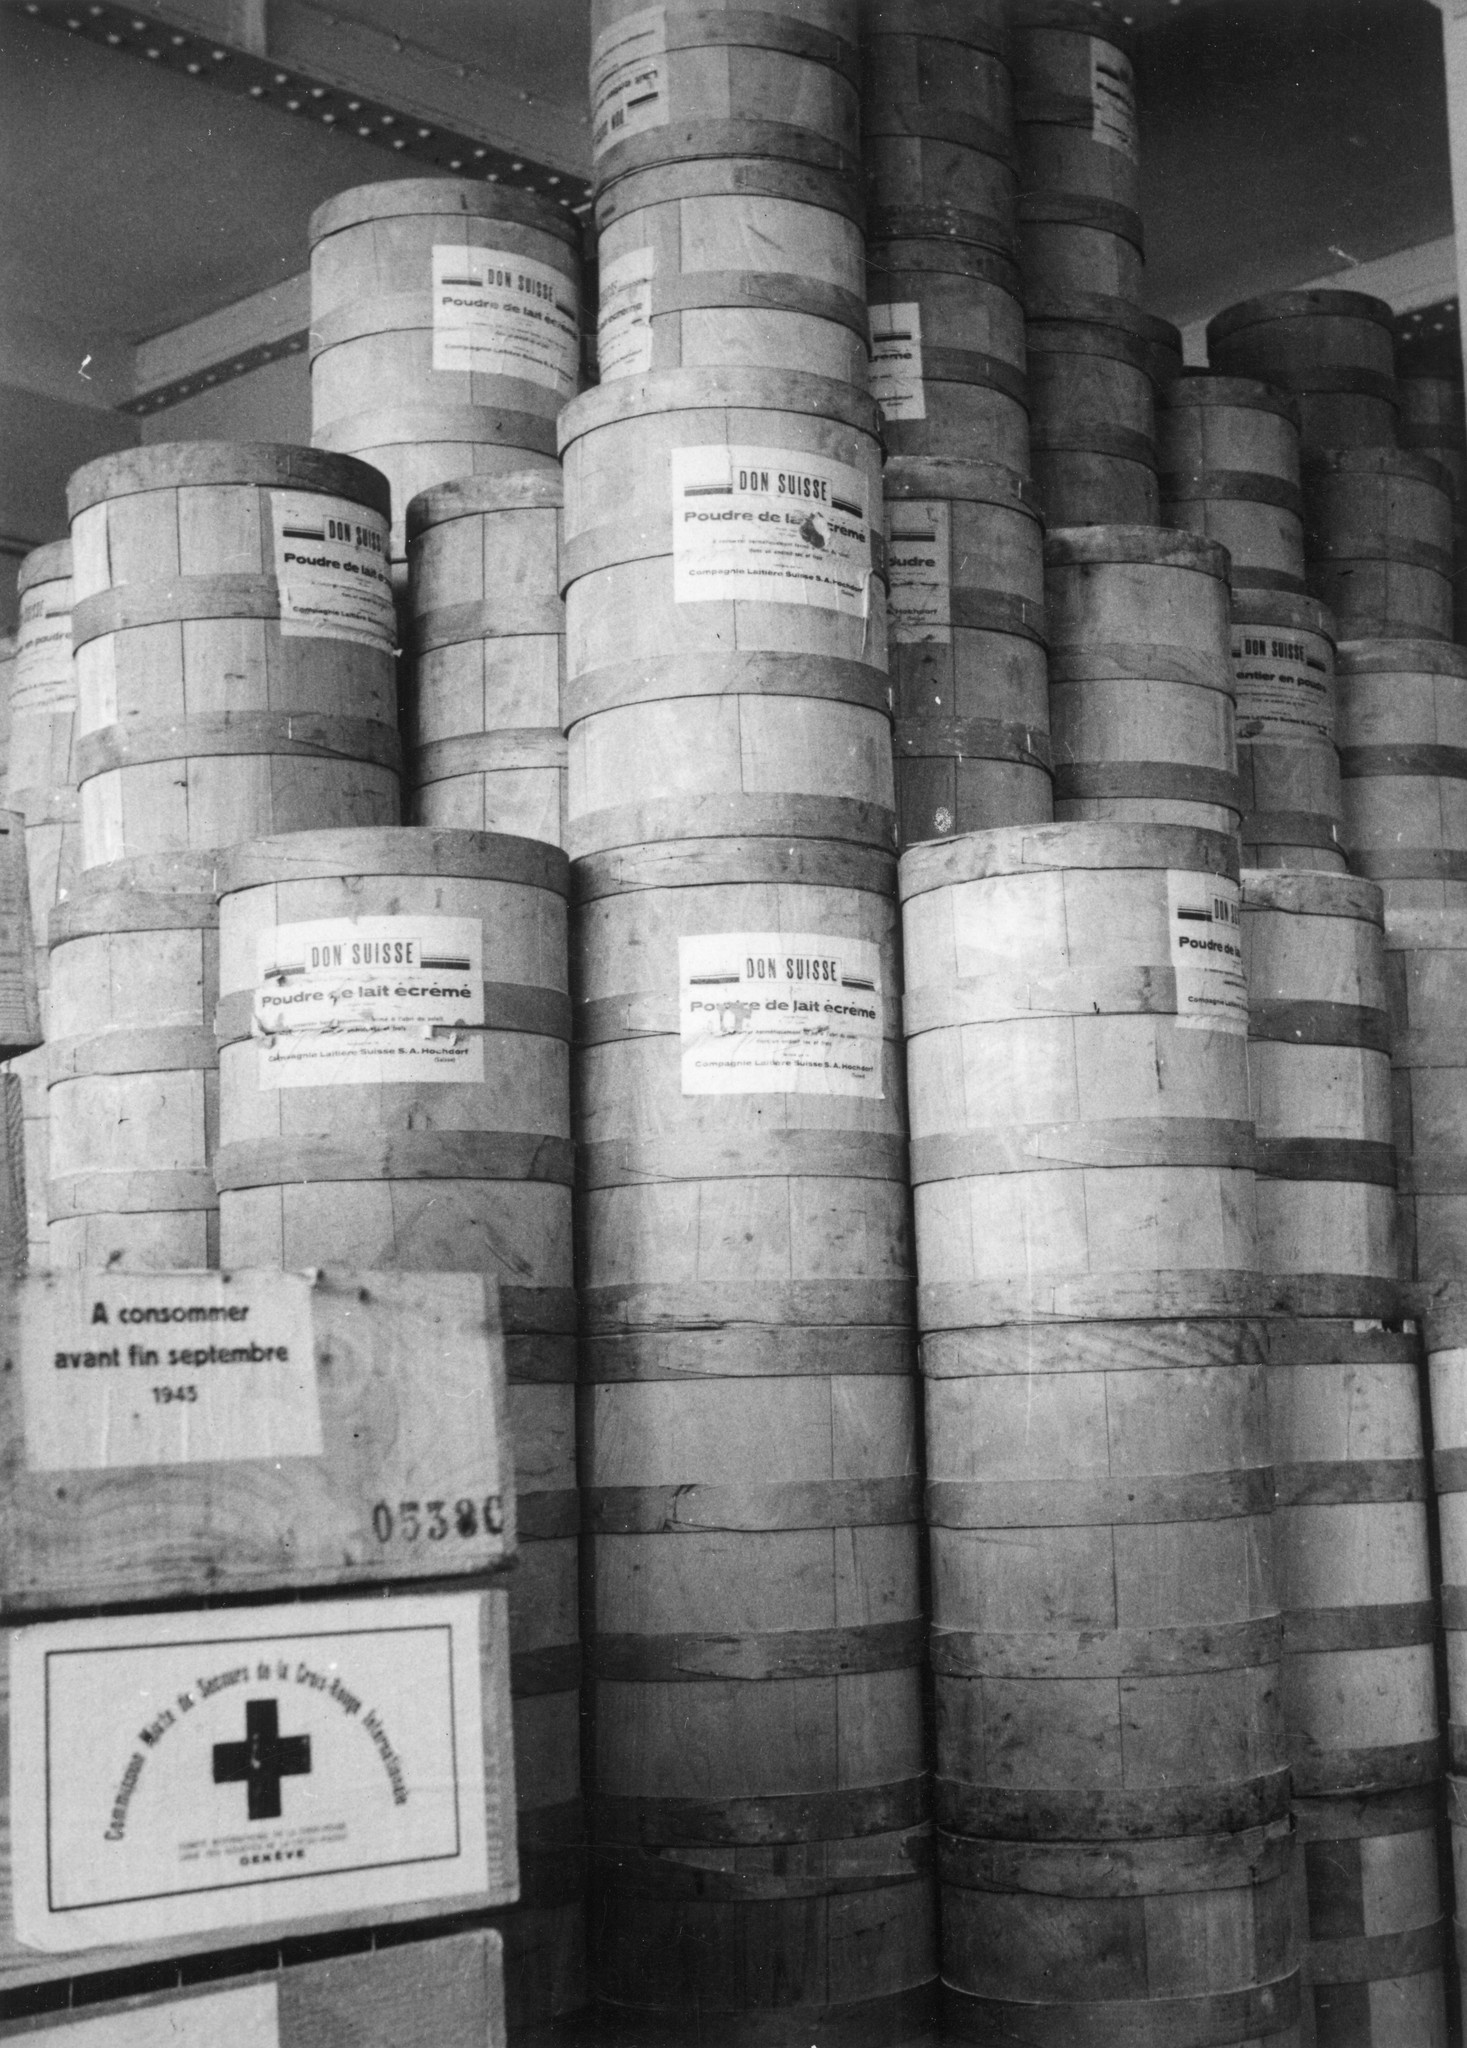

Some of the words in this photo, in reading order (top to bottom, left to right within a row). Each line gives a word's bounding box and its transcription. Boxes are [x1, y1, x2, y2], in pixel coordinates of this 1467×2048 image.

[488, 268, 512, 288] DON
[518, 274, 554, 303] SUISSE
[442, 296, 500, 310] Poudre
[503, 303, 520, 314] de
[523, 307, 542, 320] lait
[739, 470, 769, 493] DON
[778, 473, 828, 502] SUISSE
[684, 510, 753, 523] Poudre
[758, 510, 781, 523] de
[329, 519, 351, 542] DON
[284, 552, 341, 569] Poudre
[344, 561, 360, 574] de
[361, 565, 377, 580] lait
[688, 568, 745, 578] Compagnie
[785, 570, 814, 581] Suisse
[1245, 639, 1266, 656] DON
[1271, 641, 1304, 662] SUISSE
[1236, 671, 1275, 681] entier
[1279, 675, 1294, 684] en
[1214, 898, 1229, 922] DON
[311, 945, 342, 968] DON
[352, 942, 413, 964] SUISSE
[1179, 936, 1224, 953] Poudre
[1224, 943, 1234, 956] de
[746, 957, 777, 979] DON
[786, 958, 838, 982] SUISSE
[262, 991, 324, 1008] Poudre
[358, 985, 390, 998] lait
[393, 982, 472, 998] écrémé
[765, 1000, 790, 1011] de
[793, 999, 820, 1013] lait
[824, 999, 876, 1020] écrémé
[360, 1048, 395, 1056] Suisse
[695, 1060, 752, 1069] Compagnie
[793, 1059, 823, 1068] Suisse
[91, 1301, 109, 1325] A
[118, 1305, 250, 1325] consommer
[54, 1347, 120, 1369] avant
[128, 1343, 159, 1366] fin
[168, 1341, 289, 1368] septembre
[197, 1667, 249, 1699] Secours
[362, 1709, 407, 1806] Internationale
